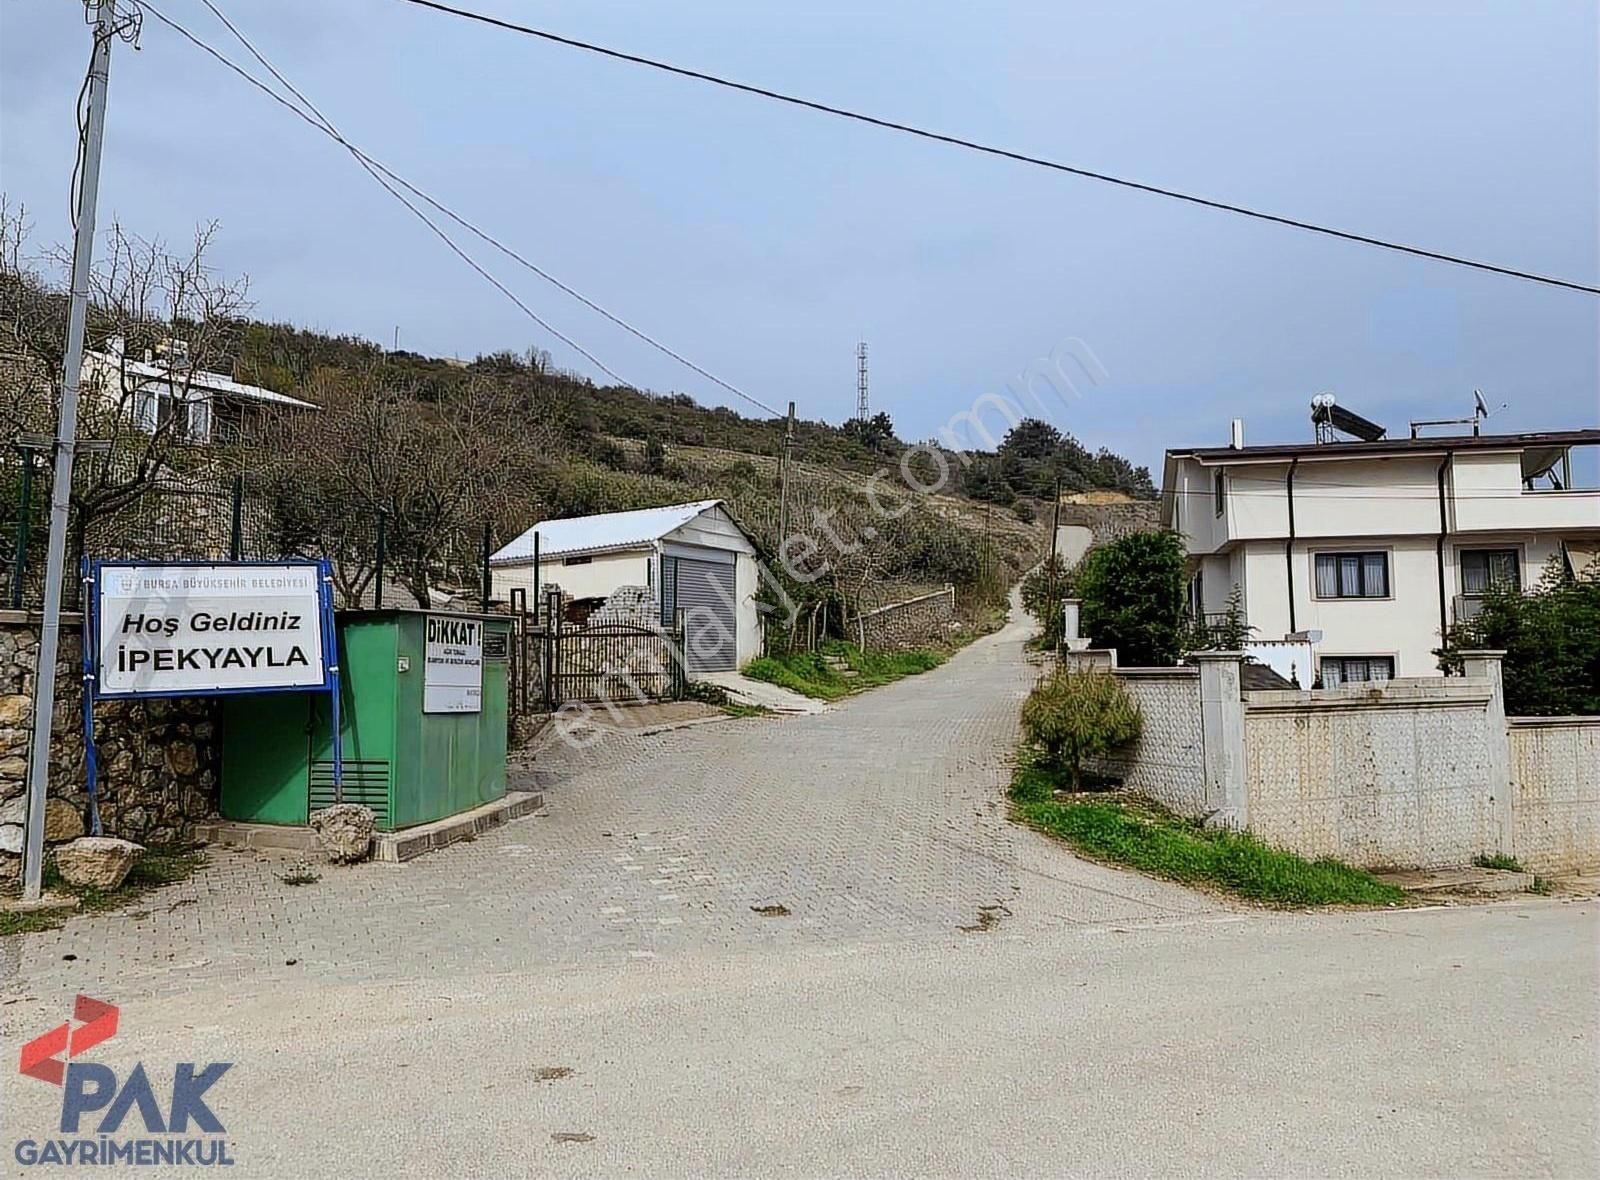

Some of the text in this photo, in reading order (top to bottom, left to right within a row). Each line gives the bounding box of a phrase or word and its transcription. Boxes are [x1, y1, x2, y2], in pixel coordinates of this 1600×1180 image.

[143, 578, 178, 590] BURSA
[251, 574, 308, 588] BELEDİYESİ
[122, 611, 302, 637] Hoş Geldiniz
[117, 645, 309, 673] İPEKYAYLA
